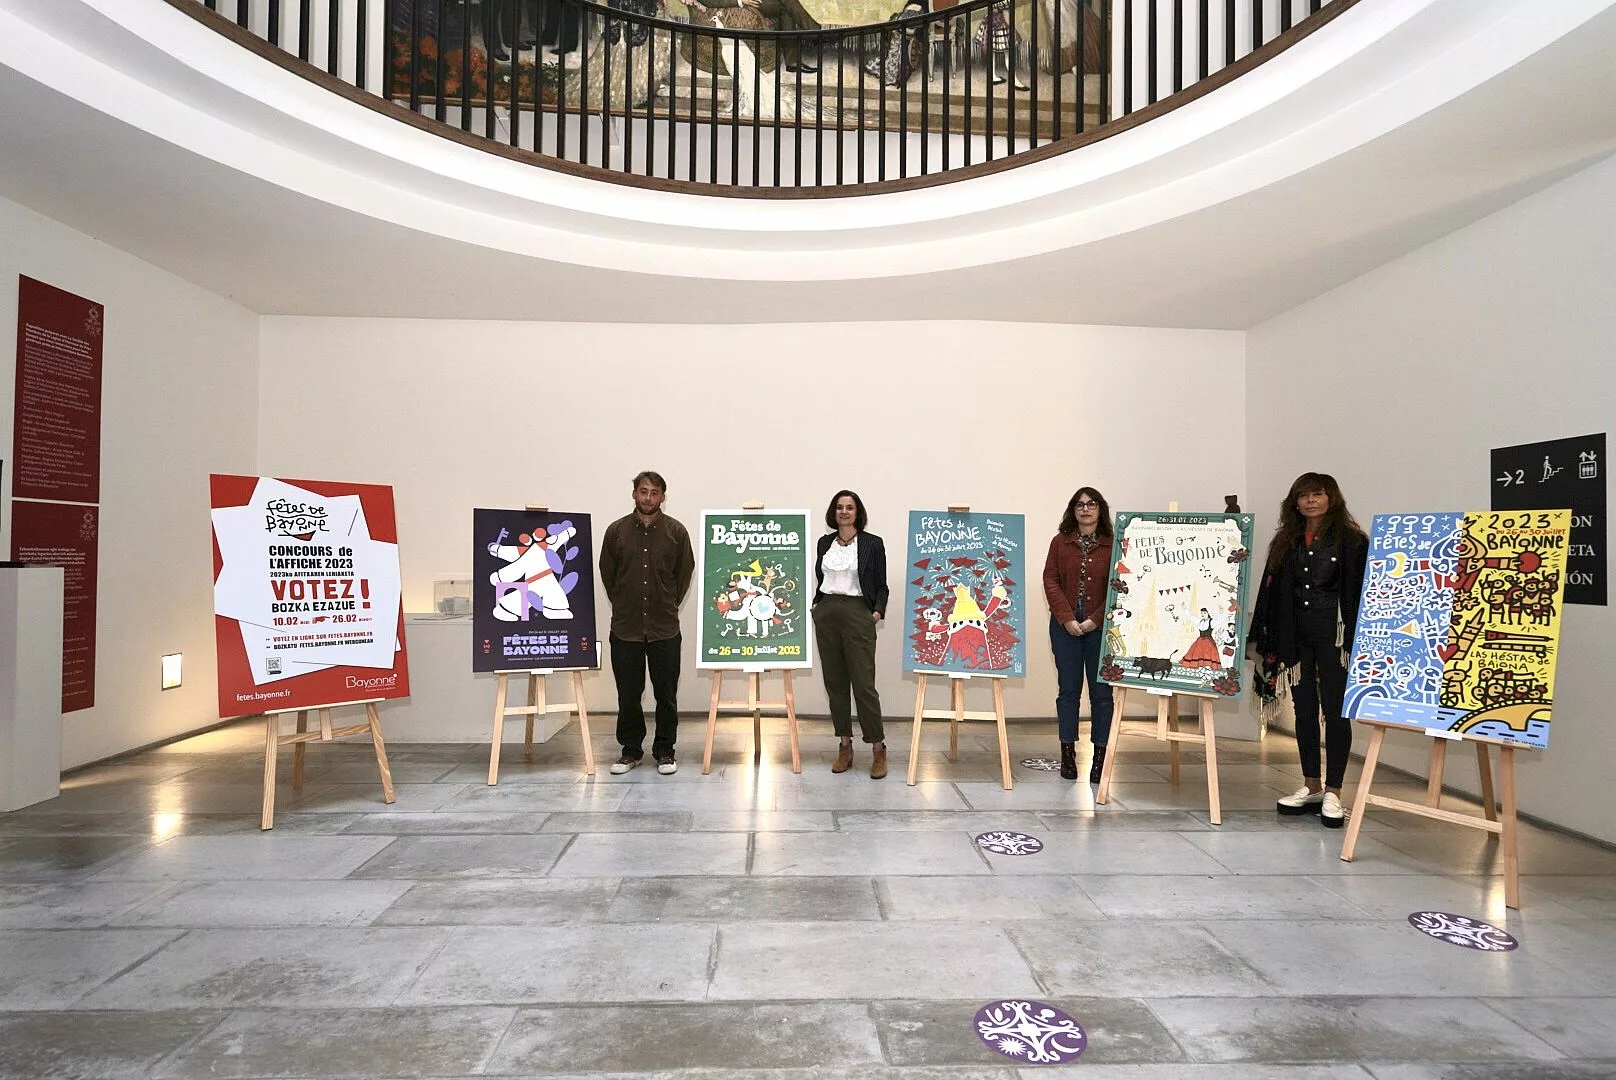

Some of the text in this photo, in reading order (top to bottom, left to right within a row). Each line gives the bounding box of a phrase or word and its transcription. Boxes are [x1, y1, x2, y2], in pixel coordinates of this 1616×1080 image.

[1515, 469, 1525, 485] 2
[730, 519, 781, 531] Fêtes de
[921, 516, 965, 529] Fêtes de
[1488, 513, 1551, 529] 2023
[710, 524, 799, 553] Bayonne
[915, 526, 981, 547] BAYONNE
[269, 545, 353, 556] CONCOURS de
[1140, 545, 1226, 566] DE Bayonne
[269, 558, 353, 569] L'AFFICHE 2023
[271, 578, 371, 609] VOTEZ !
[271, 601, 356, 613] BOZKA EZAZUE
[273, 616, 298, 626] 10.02
[332, 614, 357, 623] 26.02
[503, 633, 568, 645] FÊTES DE
[503, 645, 568, 656] BAYONNE
[719, 646, 731, 655] 26
[741, 646, 753, 656] 30
[753, 645, 777, 655] juillet
[778, 645, 800, 655] 2023
[346, 674, 397, 688] Bayonne
[236, 689, 291, 701] fetes.bayonne.fr
